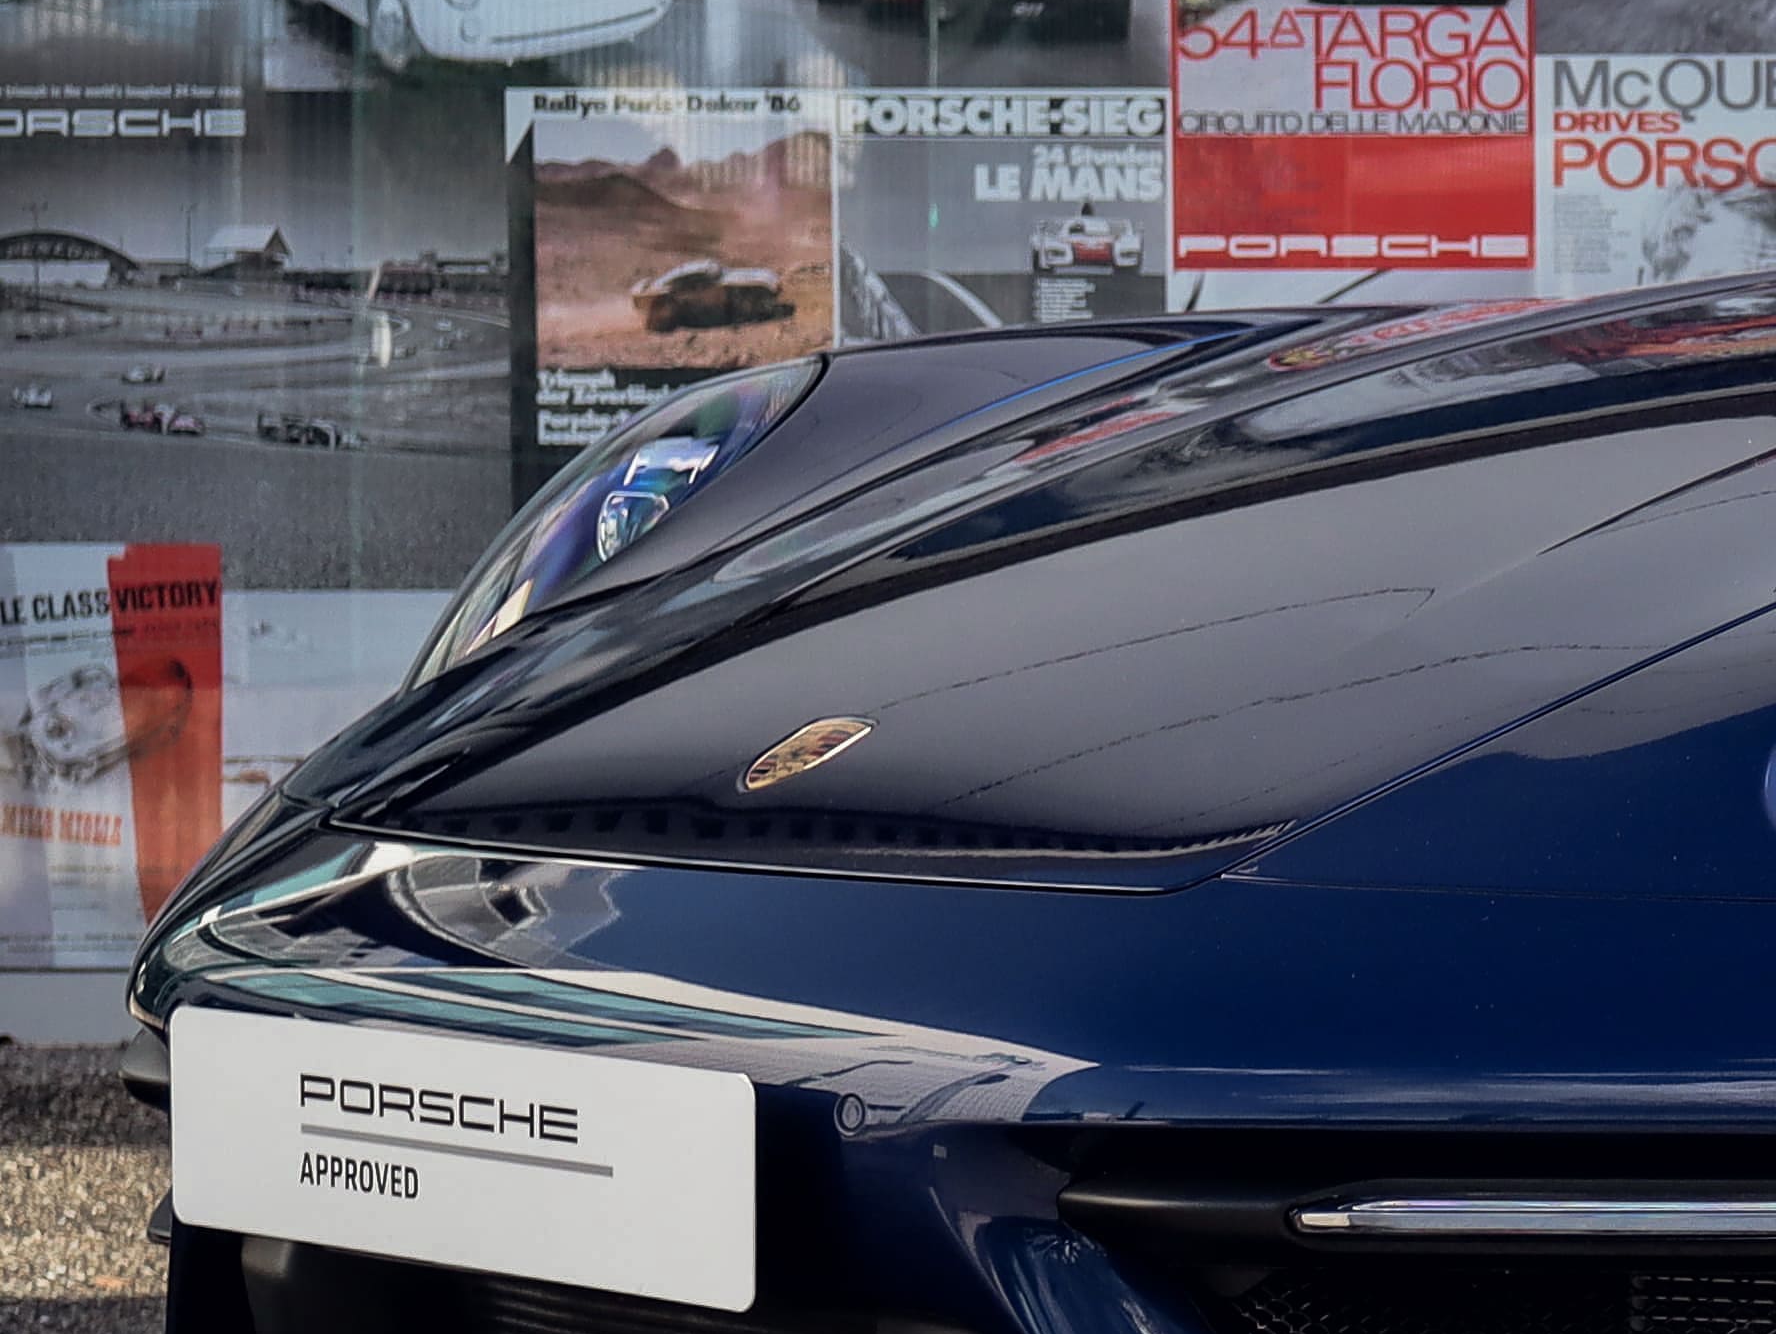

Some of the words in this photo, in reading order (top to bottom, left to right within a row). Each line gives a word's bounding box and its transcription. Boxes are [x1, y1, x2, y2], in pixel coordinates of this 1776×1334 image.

[1294, 7, 1526, 60] TARGA
[533, 91, 606, 119] Rallye
[1316, 61, 1528, 111] FLORIO
[840, 95, 1164, 135] PORSCHE-SIEG
[1179, 111, 1302, 135] CIRCUITO
[1308, 111, 1389, 135] DELLE
[1398, 110, 1528, 135] MADONIE
[1553, 111, 1681, 134] DRIVES
[1034, 145, 1065, 164] 24
[1071, 144, 1163, 165] Stunden
[975, 164, 1021, 201] LE
[1030, 166, 1163, 201] MANS
[1179, 234, 1529, 258] PORSCHE
[33, 590, 111, 624] CLASS
[114, 580, 219, 613] VICTORY
[300, 1074, 578, 1144] PORSCHE
[300, 1152, 419, 1200] APPROVED
